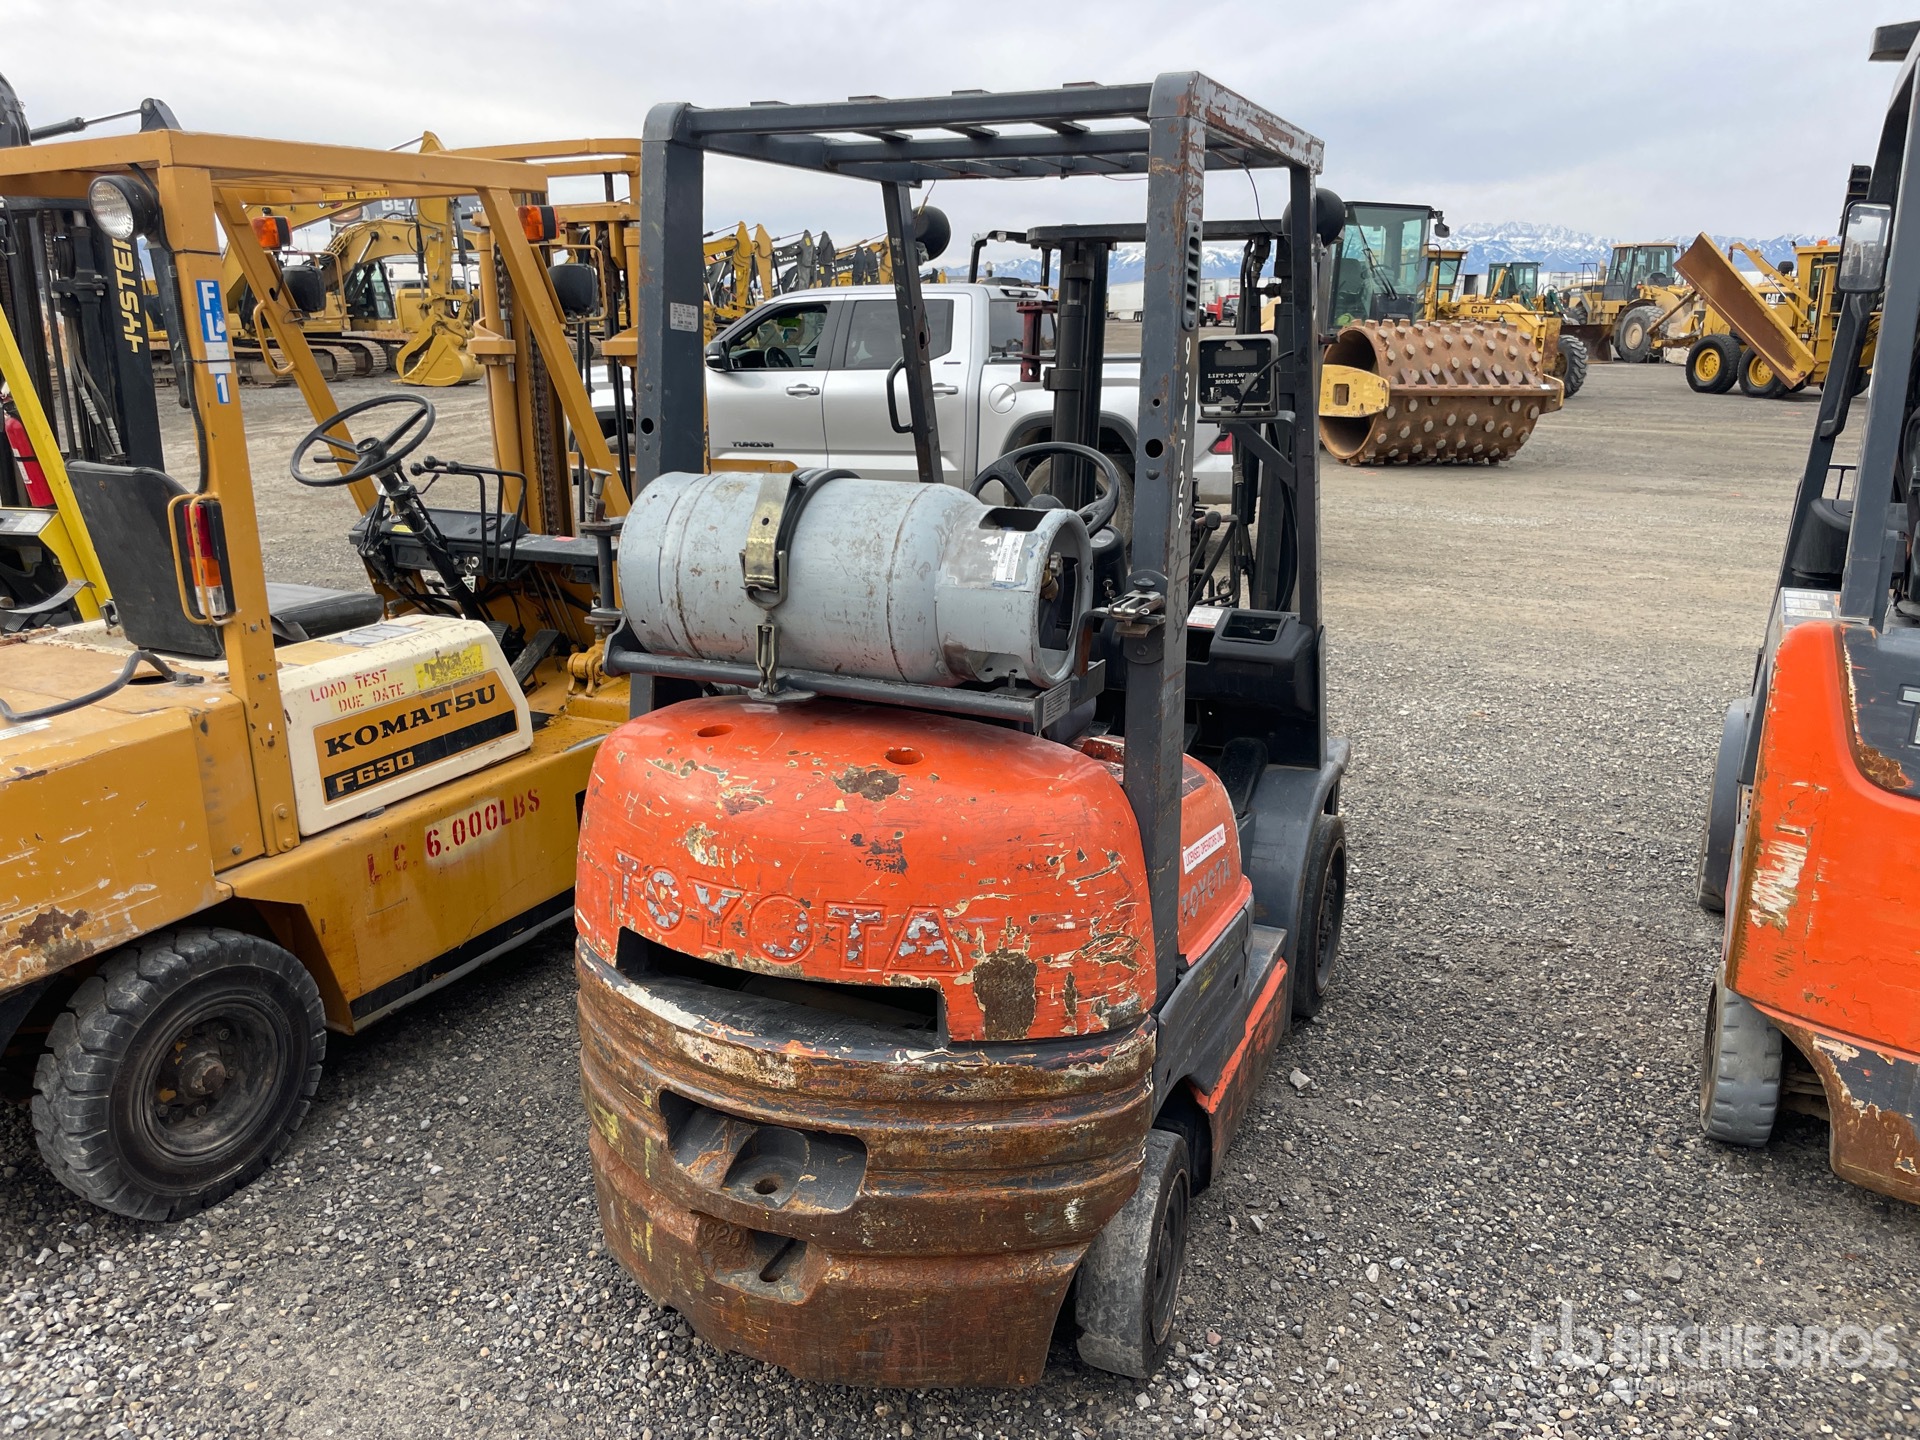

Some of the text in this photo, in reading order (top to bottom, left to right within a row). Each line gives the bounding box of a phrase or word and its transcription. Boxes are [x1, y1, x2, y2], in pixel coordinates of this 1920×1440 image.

[1471, 305, 1490, 314] CAT
[1765, 293, 1781, 304] CAT
[216, 374, 229, 403] 1
[309, 669, 388, 703] LOAD TEST
[338, 683, 406, 713] DUE DATE
[324, 684, 496, 758] KOMATSU
[335, 751, 415, 793] FG30
[612, 847, 964, 977] TOYOTA
